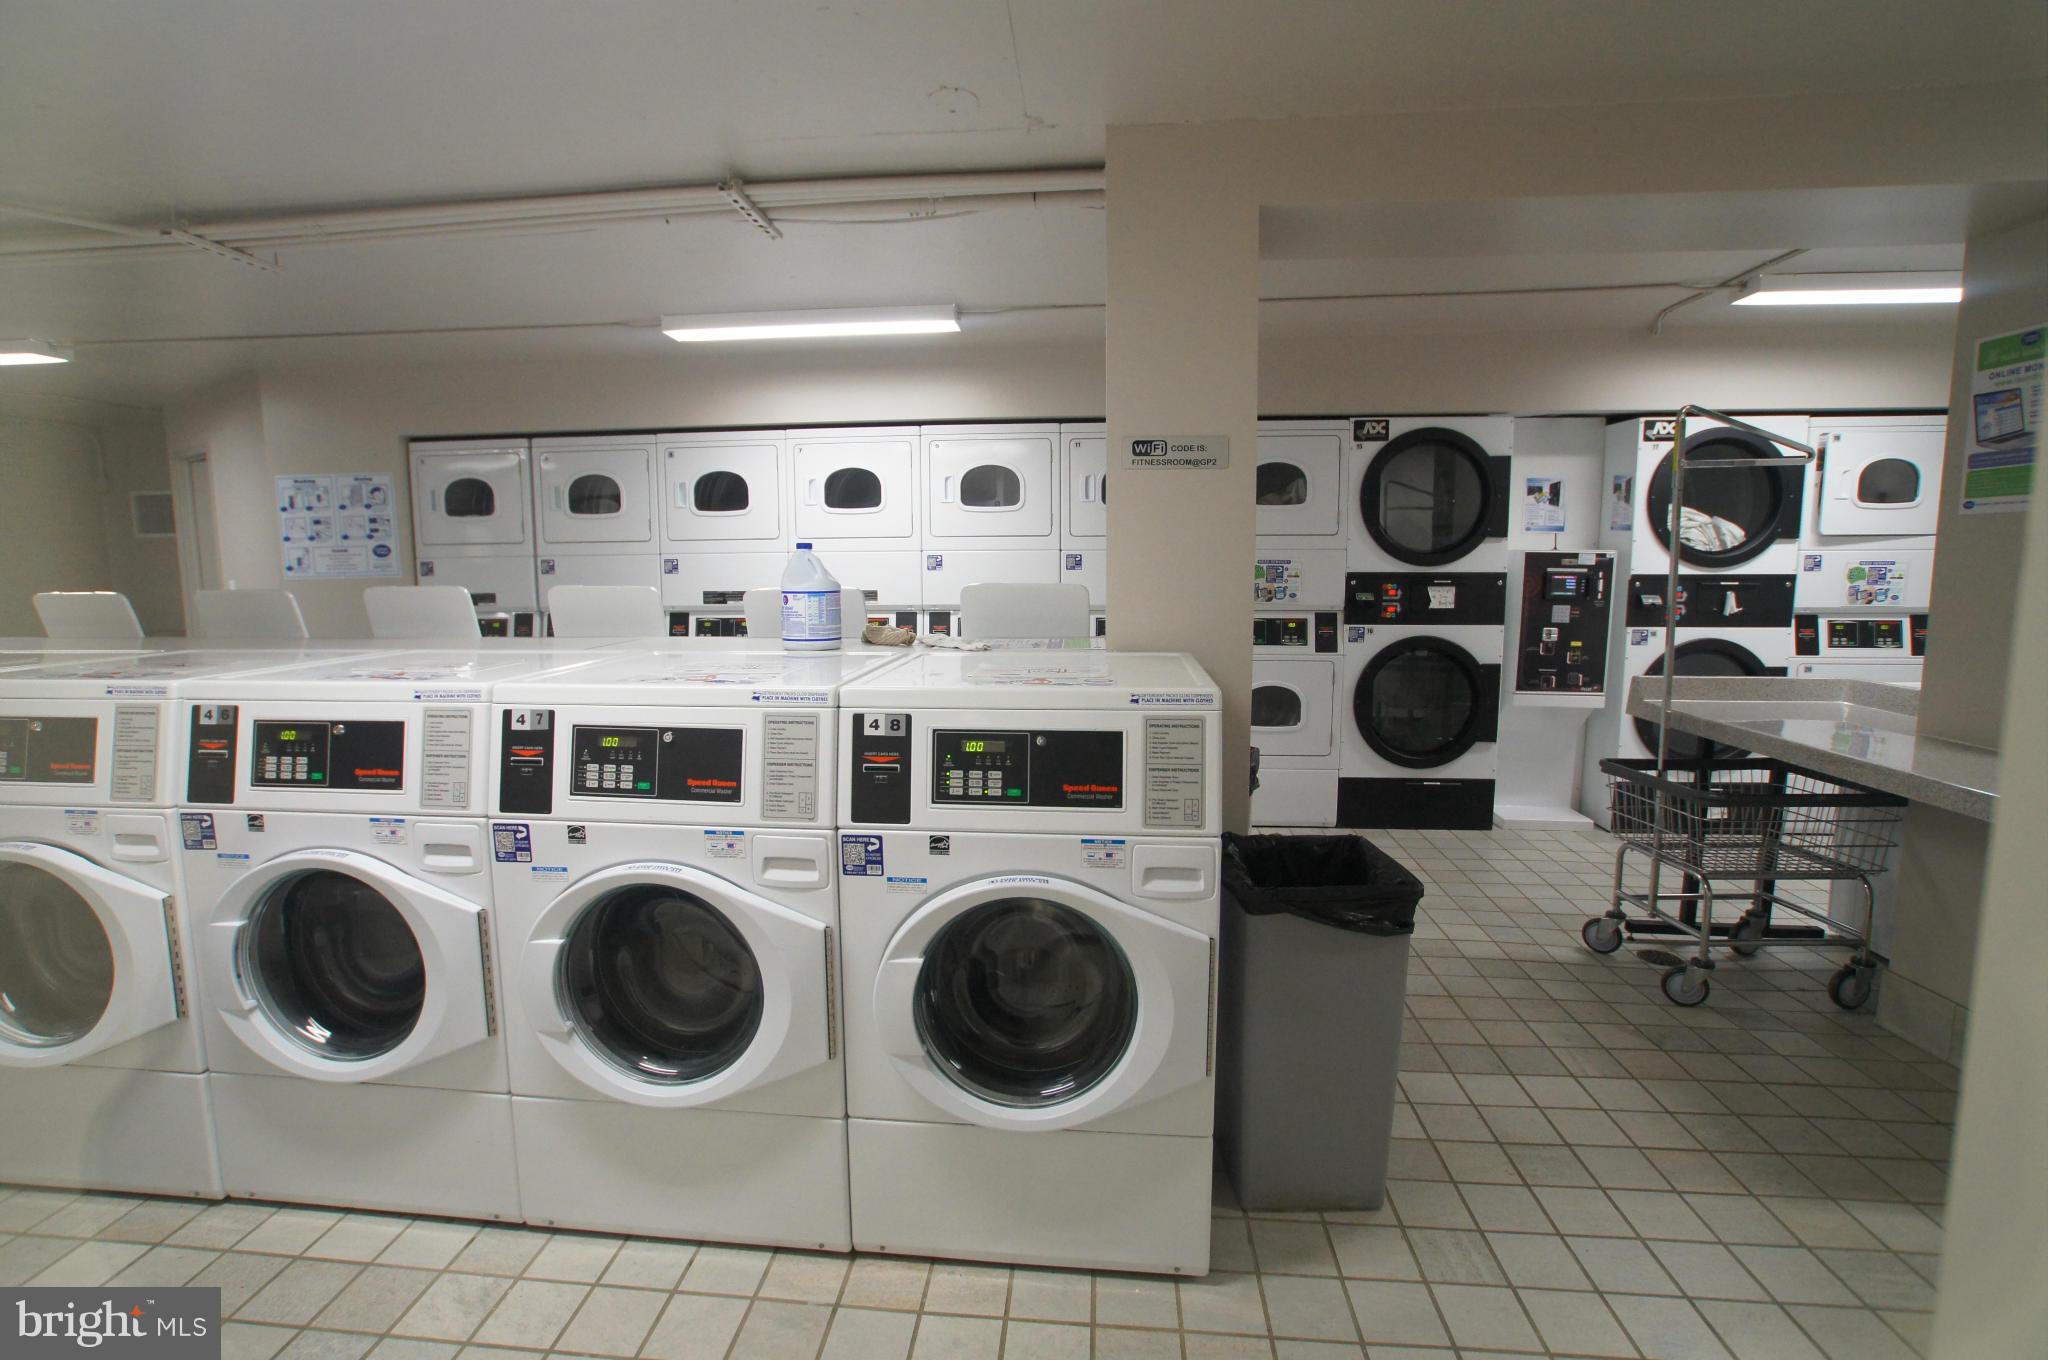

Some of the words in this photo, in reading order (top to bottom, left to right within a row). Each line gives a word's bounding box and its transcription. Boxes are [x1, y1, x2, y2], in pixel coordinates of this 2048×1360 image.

[1133, 441, 1166, 455] WiFi
[1132, 459, 1217, 467] FITNESSROOM@GP2
[687, 778, 711, 787] Speed
[1063, 784, 1089, 793] Speed
[1090, 784, 1118, 793] Queen
